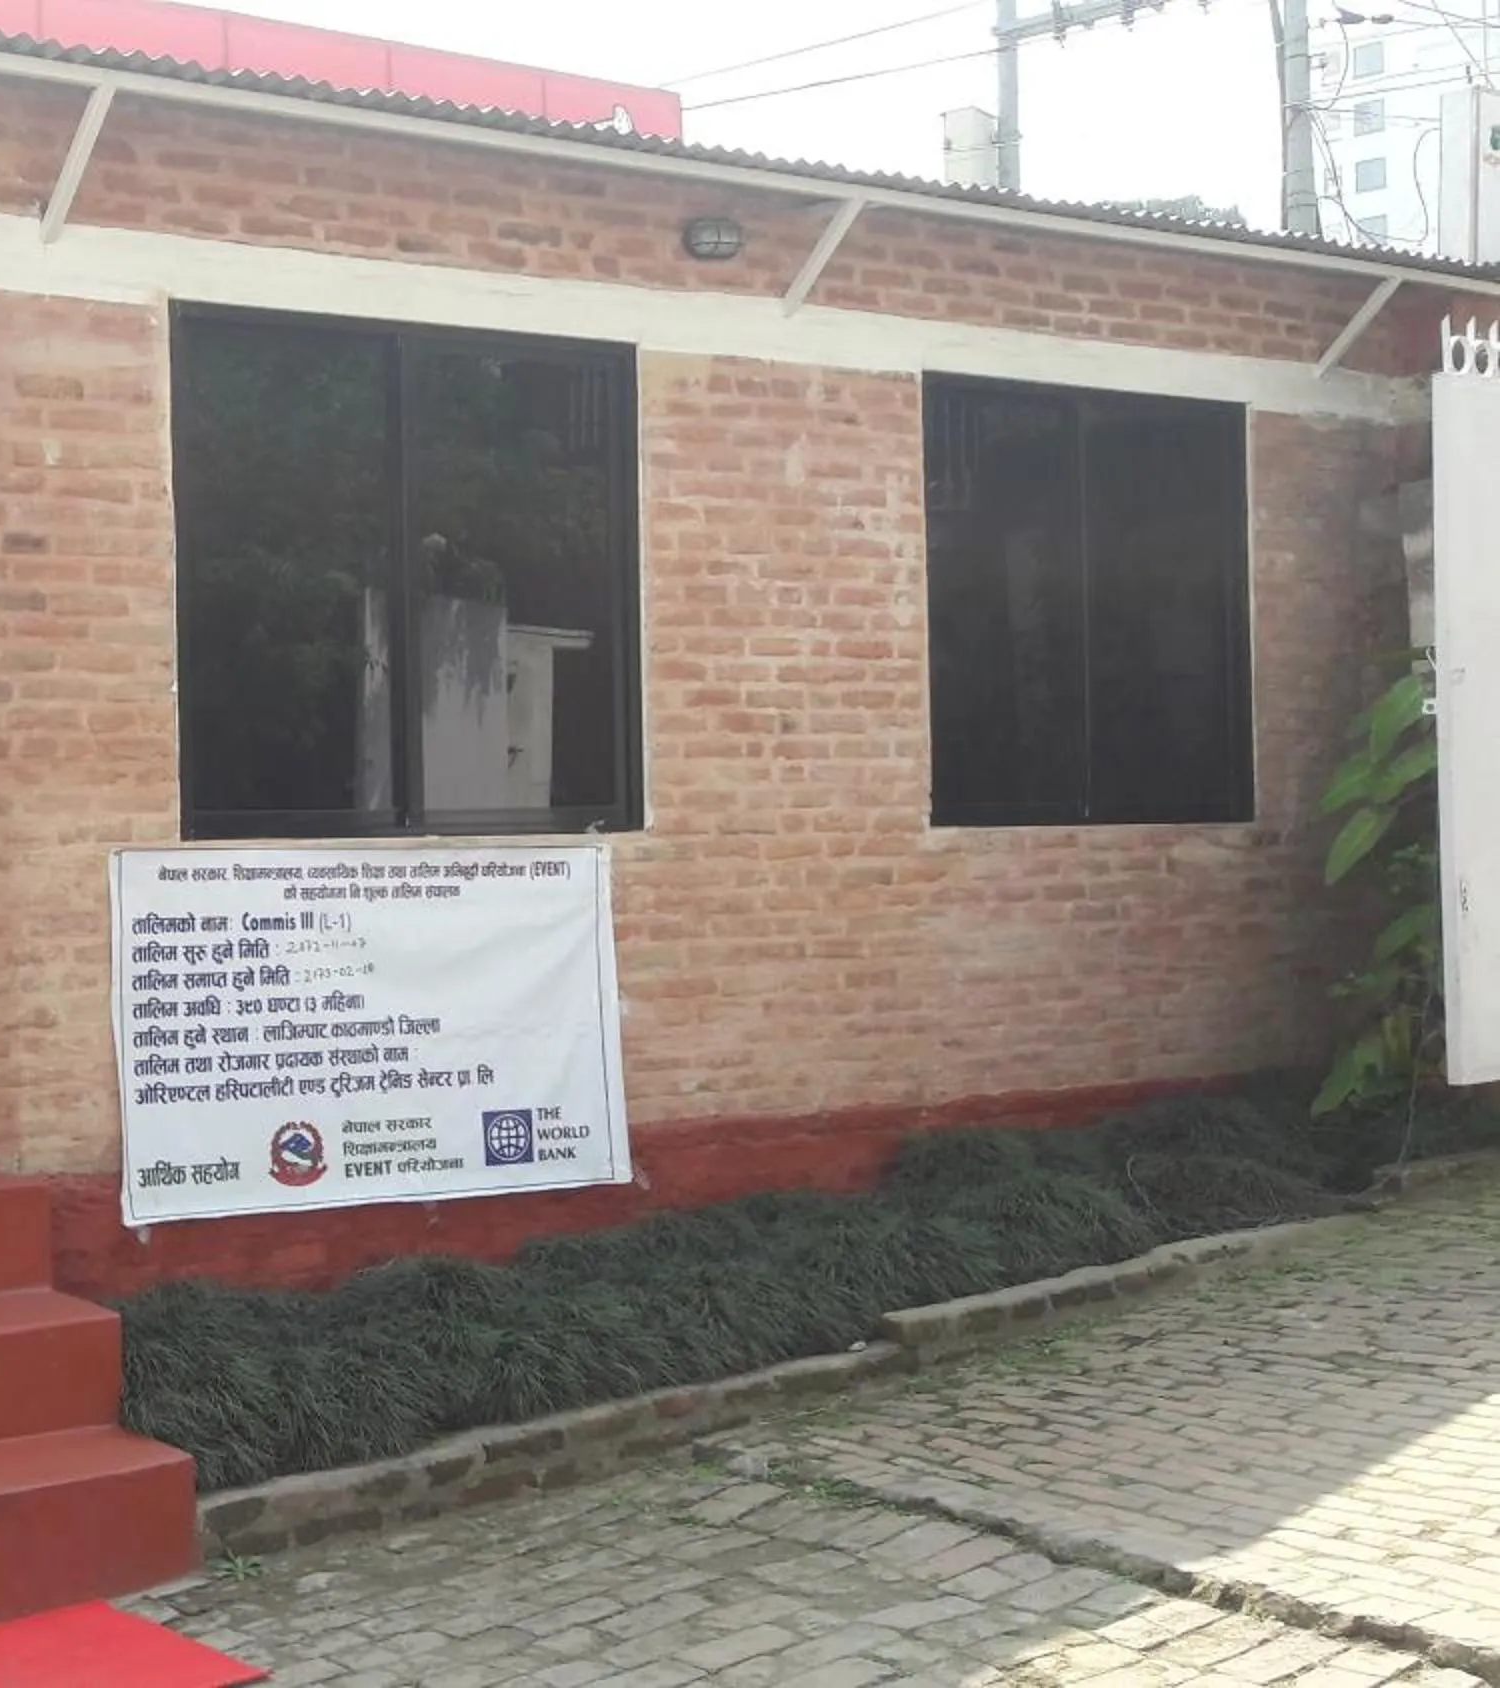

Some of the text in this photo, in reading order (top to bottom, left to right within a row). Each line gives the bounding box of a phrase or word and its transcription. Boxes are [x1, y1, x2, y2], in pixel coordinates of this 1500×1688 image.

[410, 862, 440, 880] तालिम
[529, 860, 571, 881] (EVENT)
[132, 911, 195, 935] तालिमको
[241, 911, 297, 931] Commis
[300, 911, 314, 930] III
[319, 911, 352, 934] (L-1)
[132, 940, 177, 964] तालिम
[211, 939, 234, 966] हुने
[238, 937, 270, 959] मिति
[132, 968, 178, 992] तालिम
[183, 971, 227, 991] समाप्त
[231, 966, 254, 992] हुने
[259, 963, 290, 987] मिति
[132, 997, 179, 1020] तालिम
[183, 995, 221, 1017] अवधि
[267, 996, 300, 1013] घण्टा
[133, 1024, 179, 1049] तालिम
[183, 1024, 207, 1049] हुने
[211, 1026, 249, 1046] स्थान
[263, 1019, 327, 1043] लाजिम्पाट
[398, 1013, 441, 1036] जिल्ला
[133, 1043, 409, 1077] तालिम तथा रोजगार प्रदायक संस्थाको नाम
[299, 1078, 326, 1095] एण्ड
[417, 1067, 453, 1089] सेन्टर
[341, 1117, 433, 1134] नेपाल सरकार
[536, 1107, 562, 1121] THE
[537, 1125, 590, 1141] WORLD
[537, 1147, 577, 1162] BANK
[137, 1155, 240, 1188] आर्थिक सहयोग
[344, 1157, 465, 1179] EVENT परियोजना
